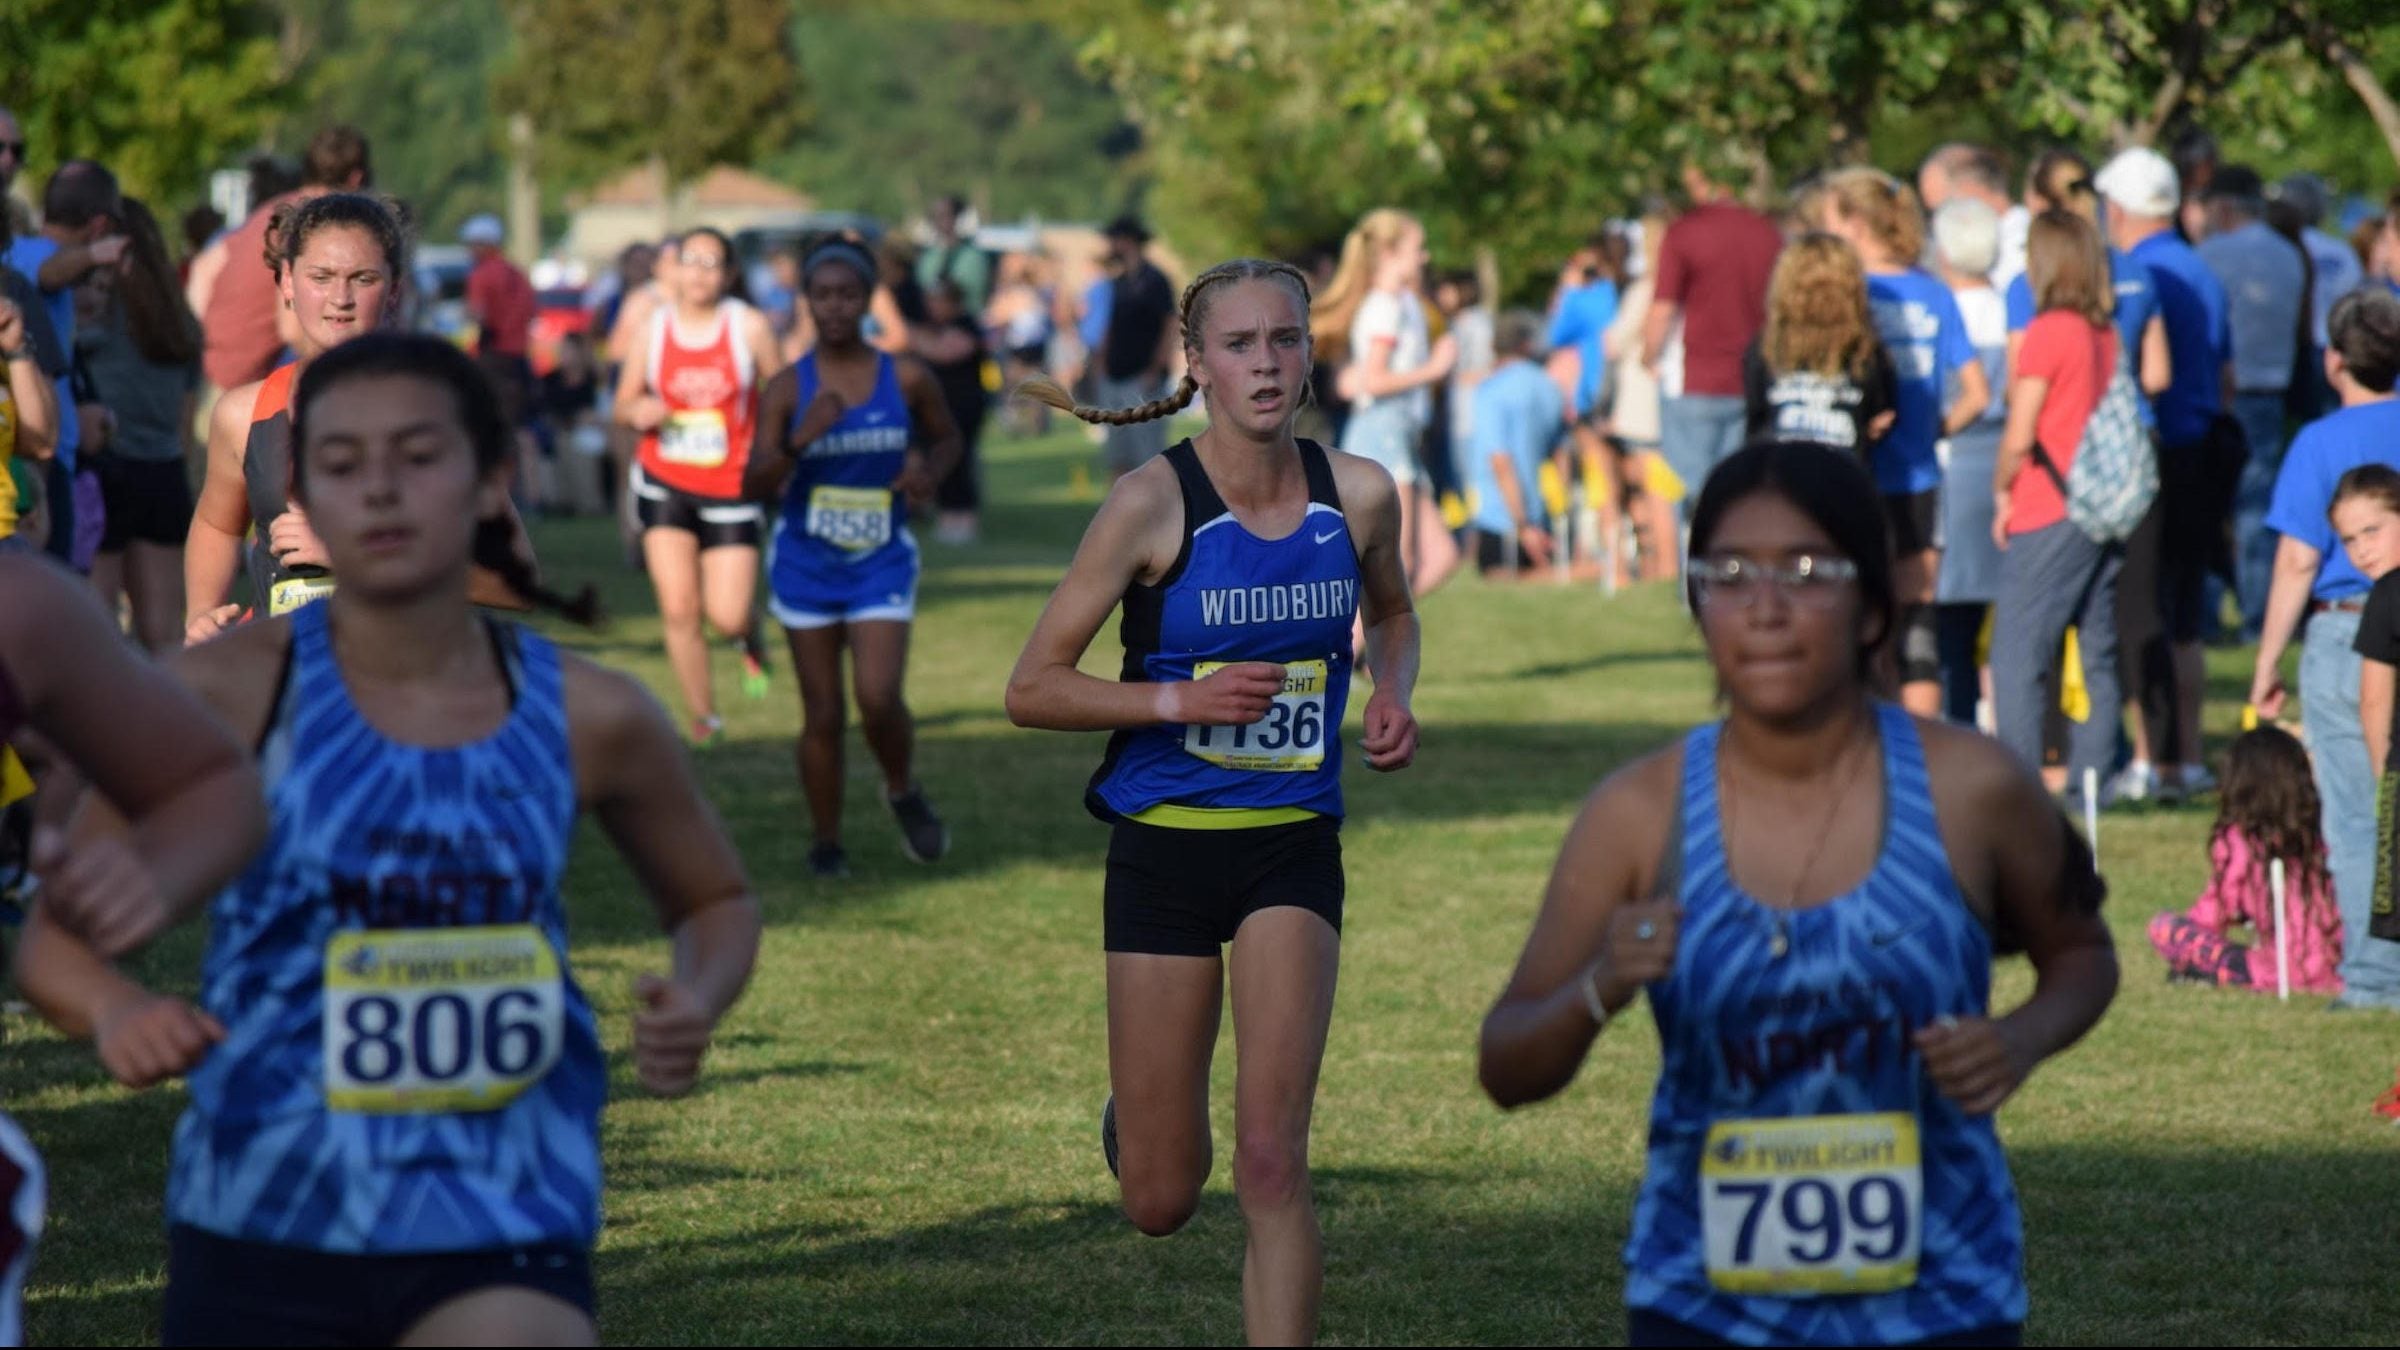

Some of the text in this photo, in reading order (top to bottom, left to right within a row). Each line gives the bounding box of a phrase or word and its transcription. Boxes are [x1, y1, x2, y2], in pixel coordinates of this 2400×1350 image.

[817, 509, 883, 540] 858
[1200, 578, 1355, 627] WOODBURY
[341, 989, 542, 1082] 806
[1715, 1176, 1909, 1265] 799
